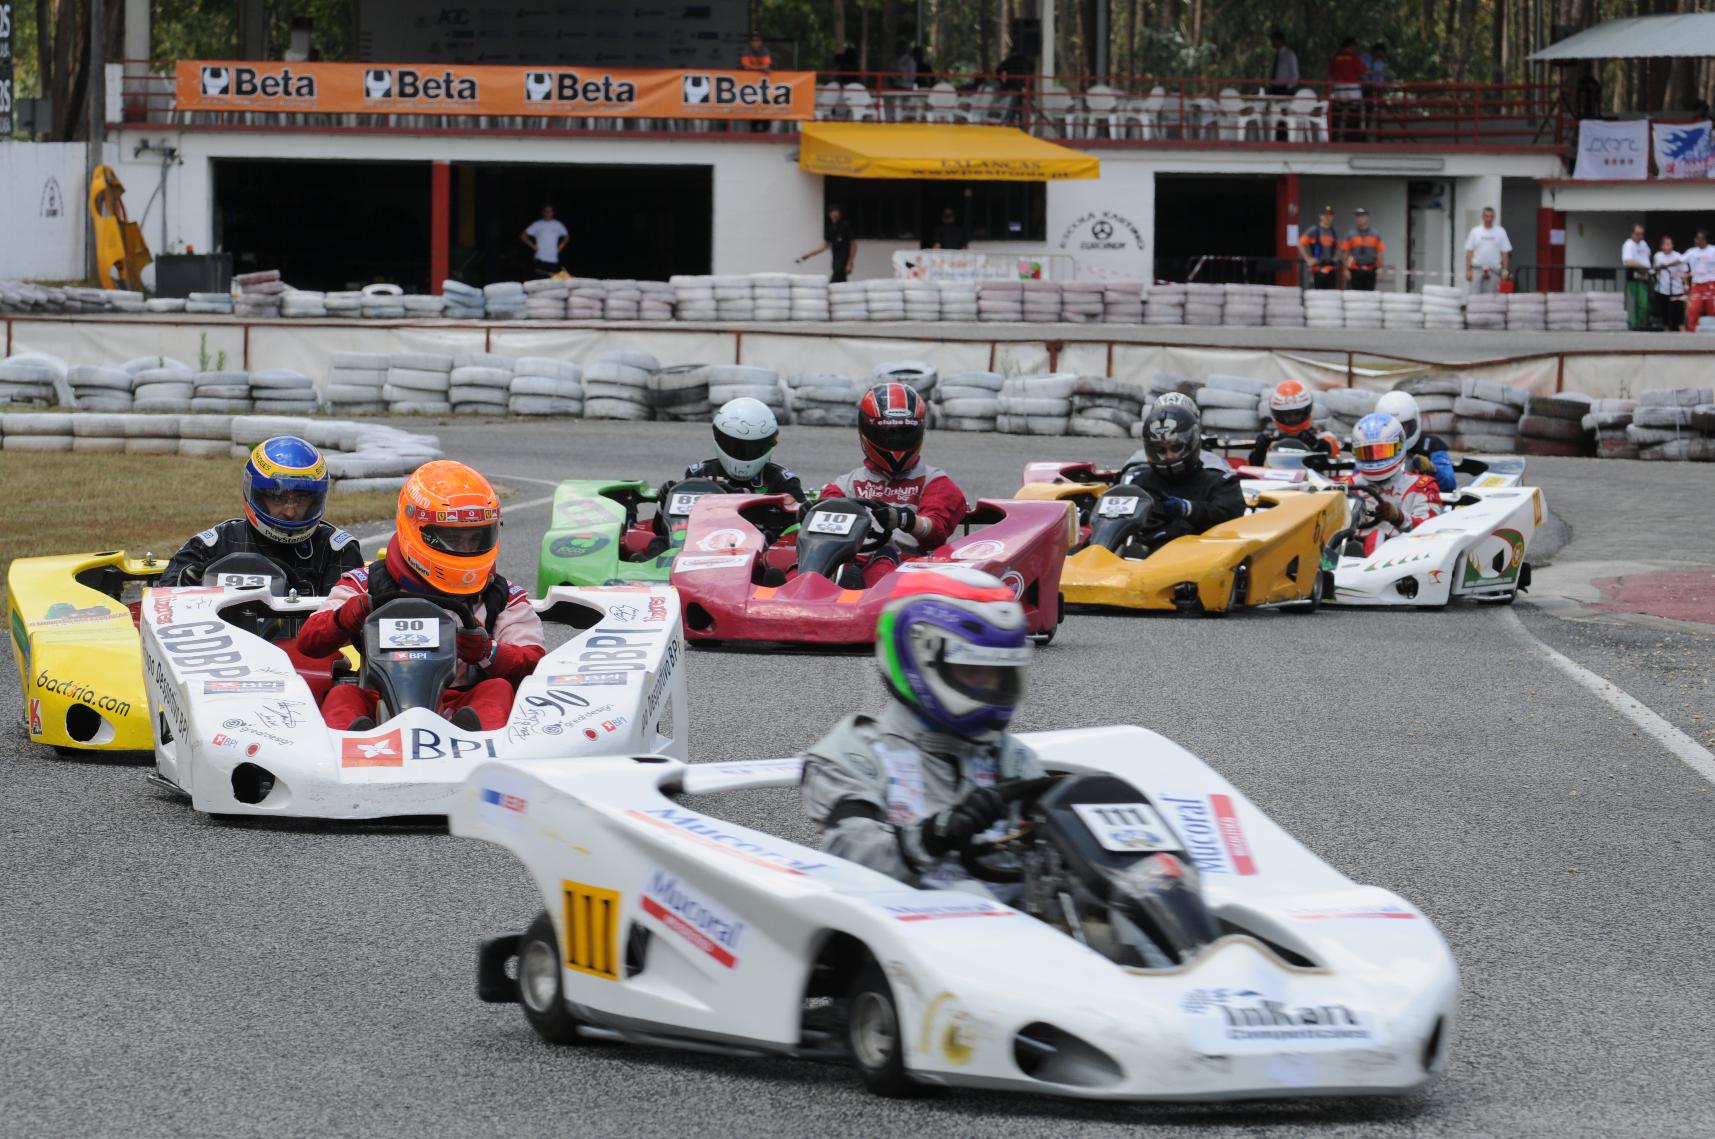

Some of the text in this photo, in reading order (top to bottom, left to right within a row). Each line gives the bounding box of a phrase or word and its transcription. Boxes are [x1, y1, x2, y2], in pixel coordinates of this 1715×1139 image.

[235, 67, 315, 97] Beta
[397, 70, 476, 100] Beta
[557, 72, 635, 103] Beta
[715, 76, 791, 105] Beta
[1108, 497, 1134, 506] 67
[822, 513, 849, 524] 10
[224, 575, 266, 587] 93
[394, 620, 424, 632] 90
[410, 727, 499, 760] BPI
[1158, 795, 1230, 874] Mucoral
[648, 868, 745, 950] Mucoral
